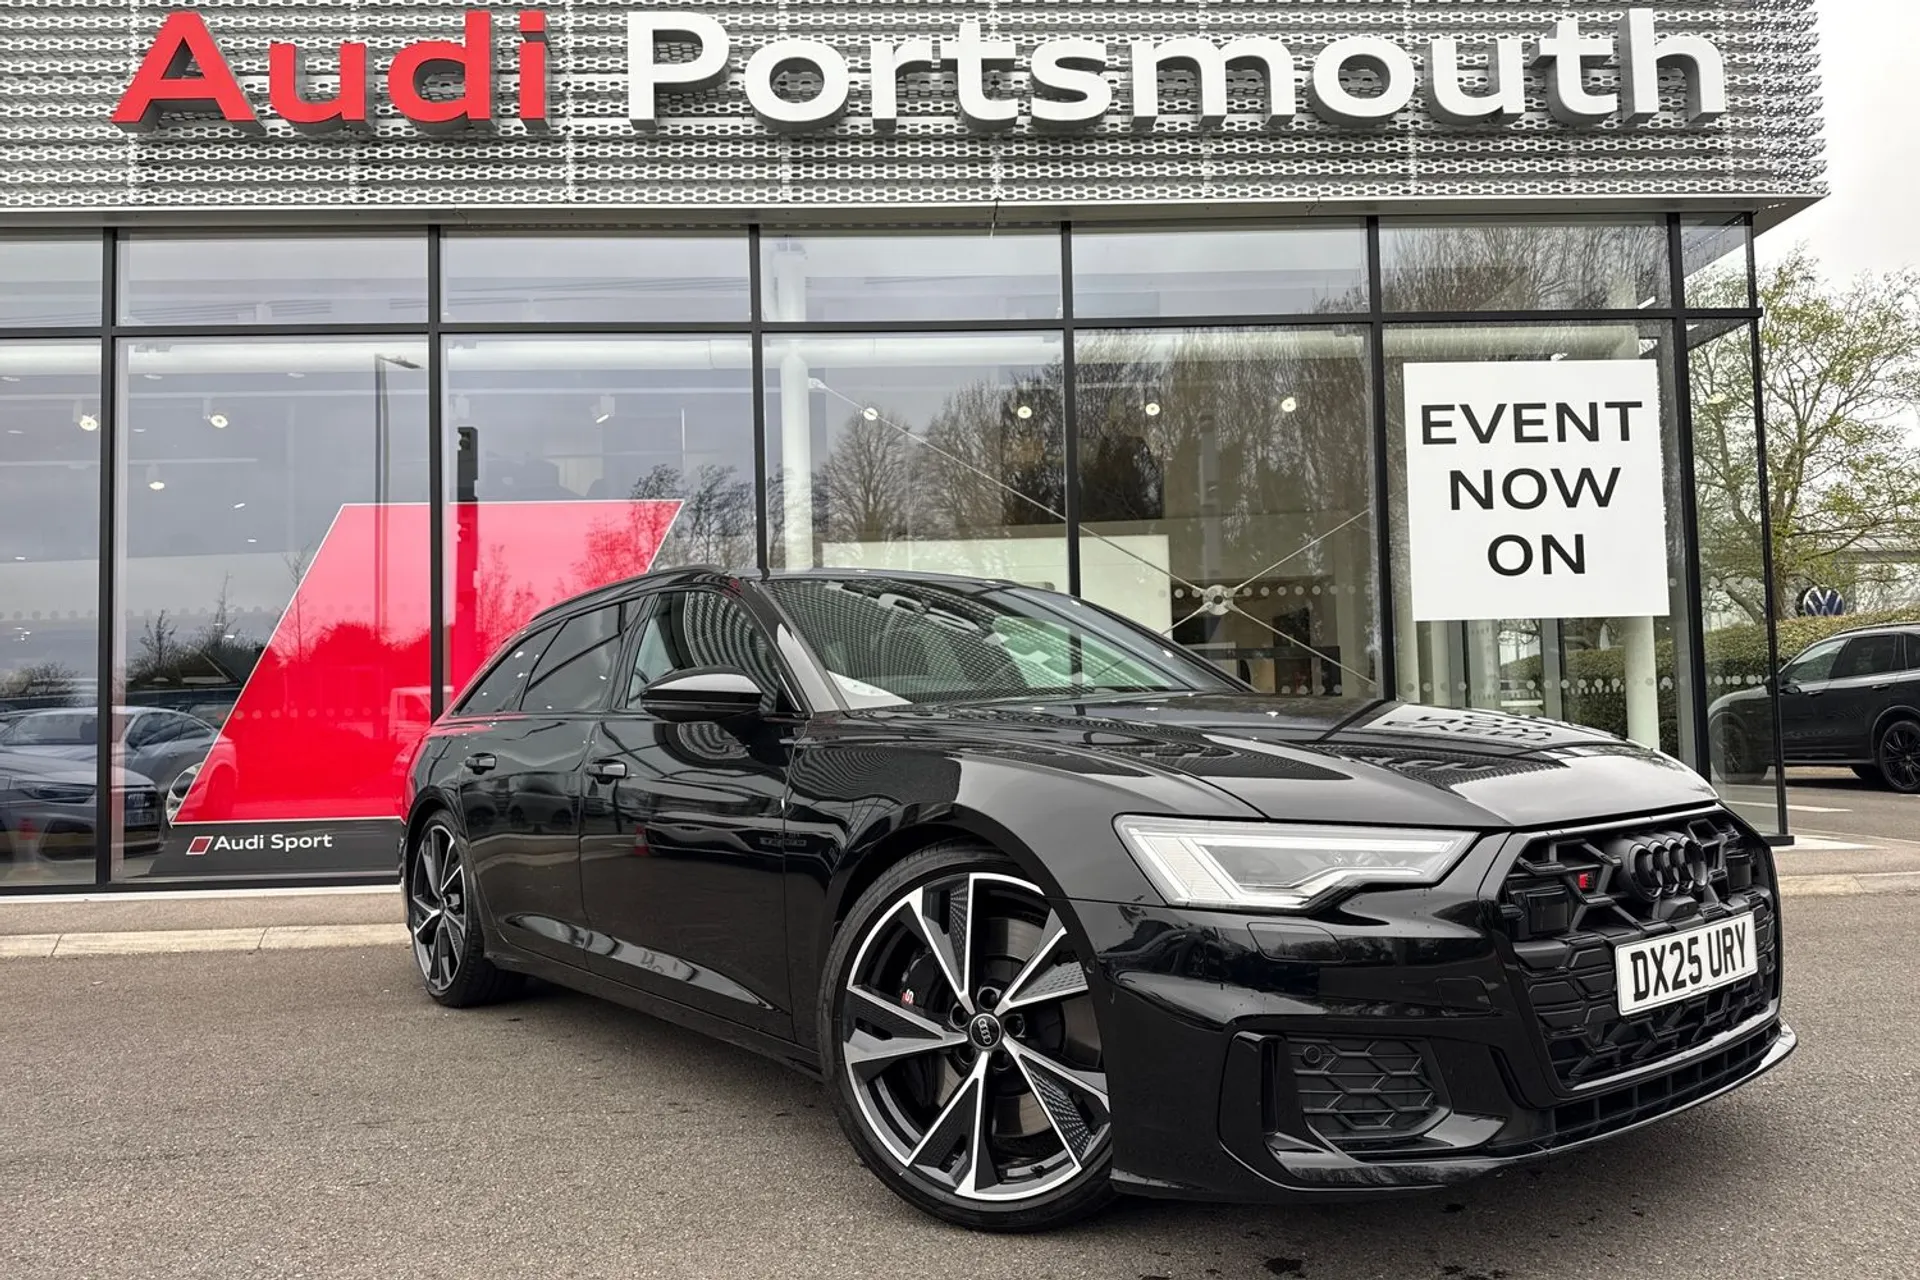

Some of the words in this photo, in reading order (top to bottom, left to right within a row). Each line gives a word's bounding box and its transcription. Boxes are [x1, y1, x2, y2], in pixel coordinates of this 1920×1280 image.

[111, 10, 549, 128] Audi
[627, 7, 1727, 127] Portsmouth
[1420, 401, 1643, 445] EVENT
[1449, 467, 1621, 511] NOW
[1487, 533, 1586, 577] ON
[213, 834, 264, 851] Audi
[270, 833, 333, 853] Sport
[1629, 935, 1704, 1003] DX25
[1707, 921, 1747, 978] URY
